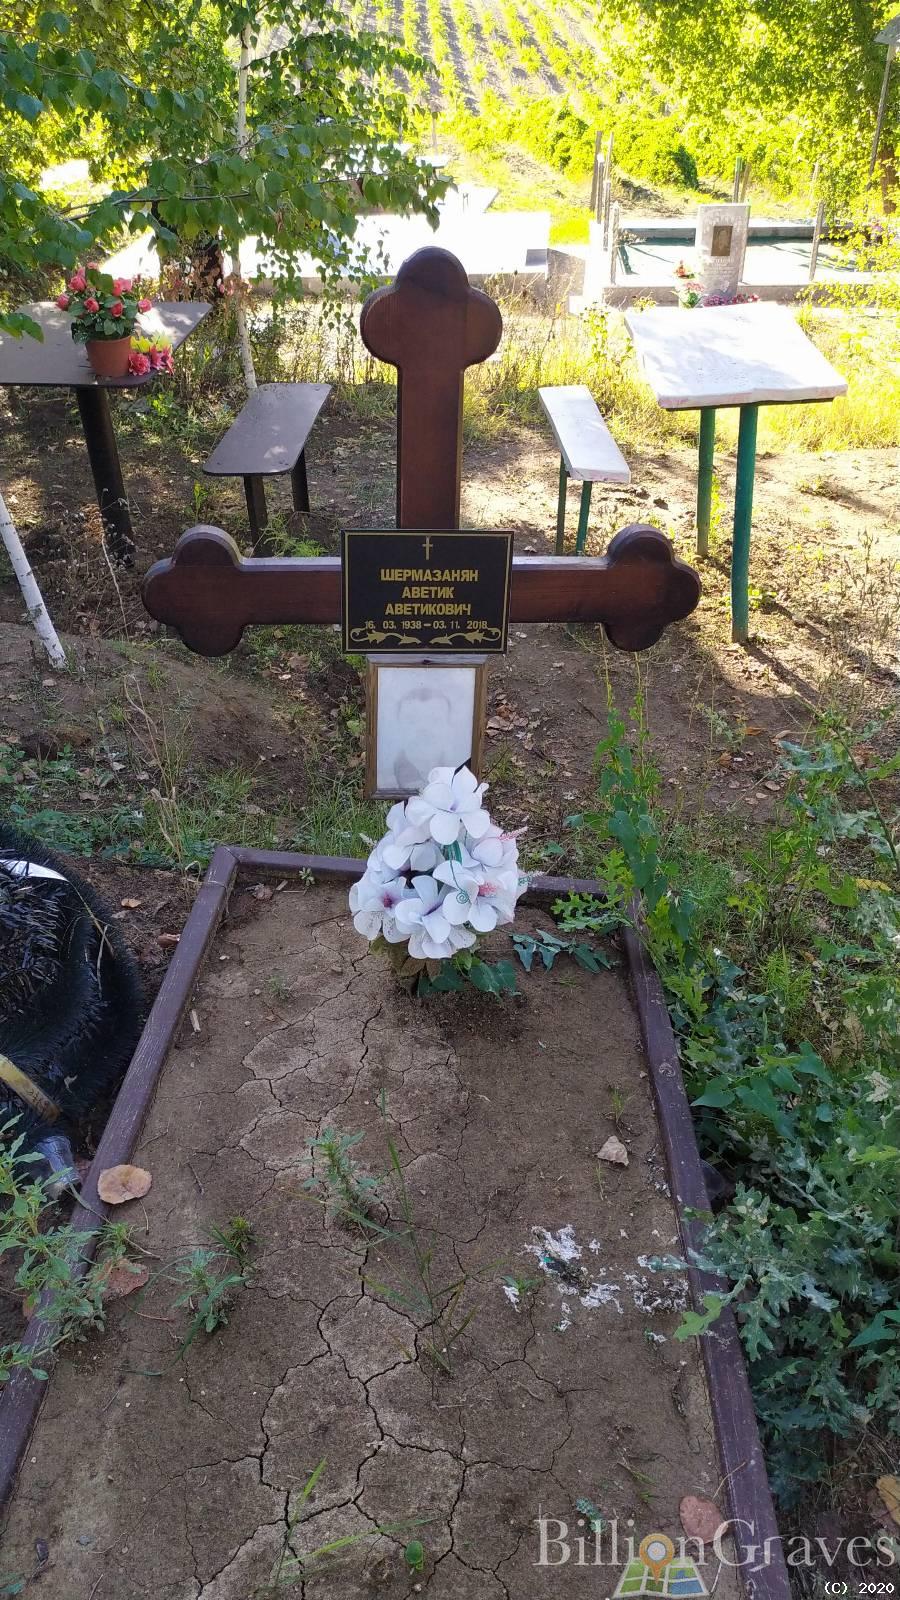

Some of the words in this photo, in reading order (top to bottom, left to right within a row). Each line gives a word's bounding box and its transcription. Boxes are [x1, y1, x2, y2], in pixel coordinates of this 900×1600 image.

[380, 569, 479, 581] ШЕРМАЗАНЯН
[401, 587, 455, 598] АВЕТИК
[384, 603, 472, 615] АВЕТИКОВИЧ
[383, 621, 396, 629] 03.
[401, 621, 421, 629] 1938
[433, 621, 447, 629] 03.
